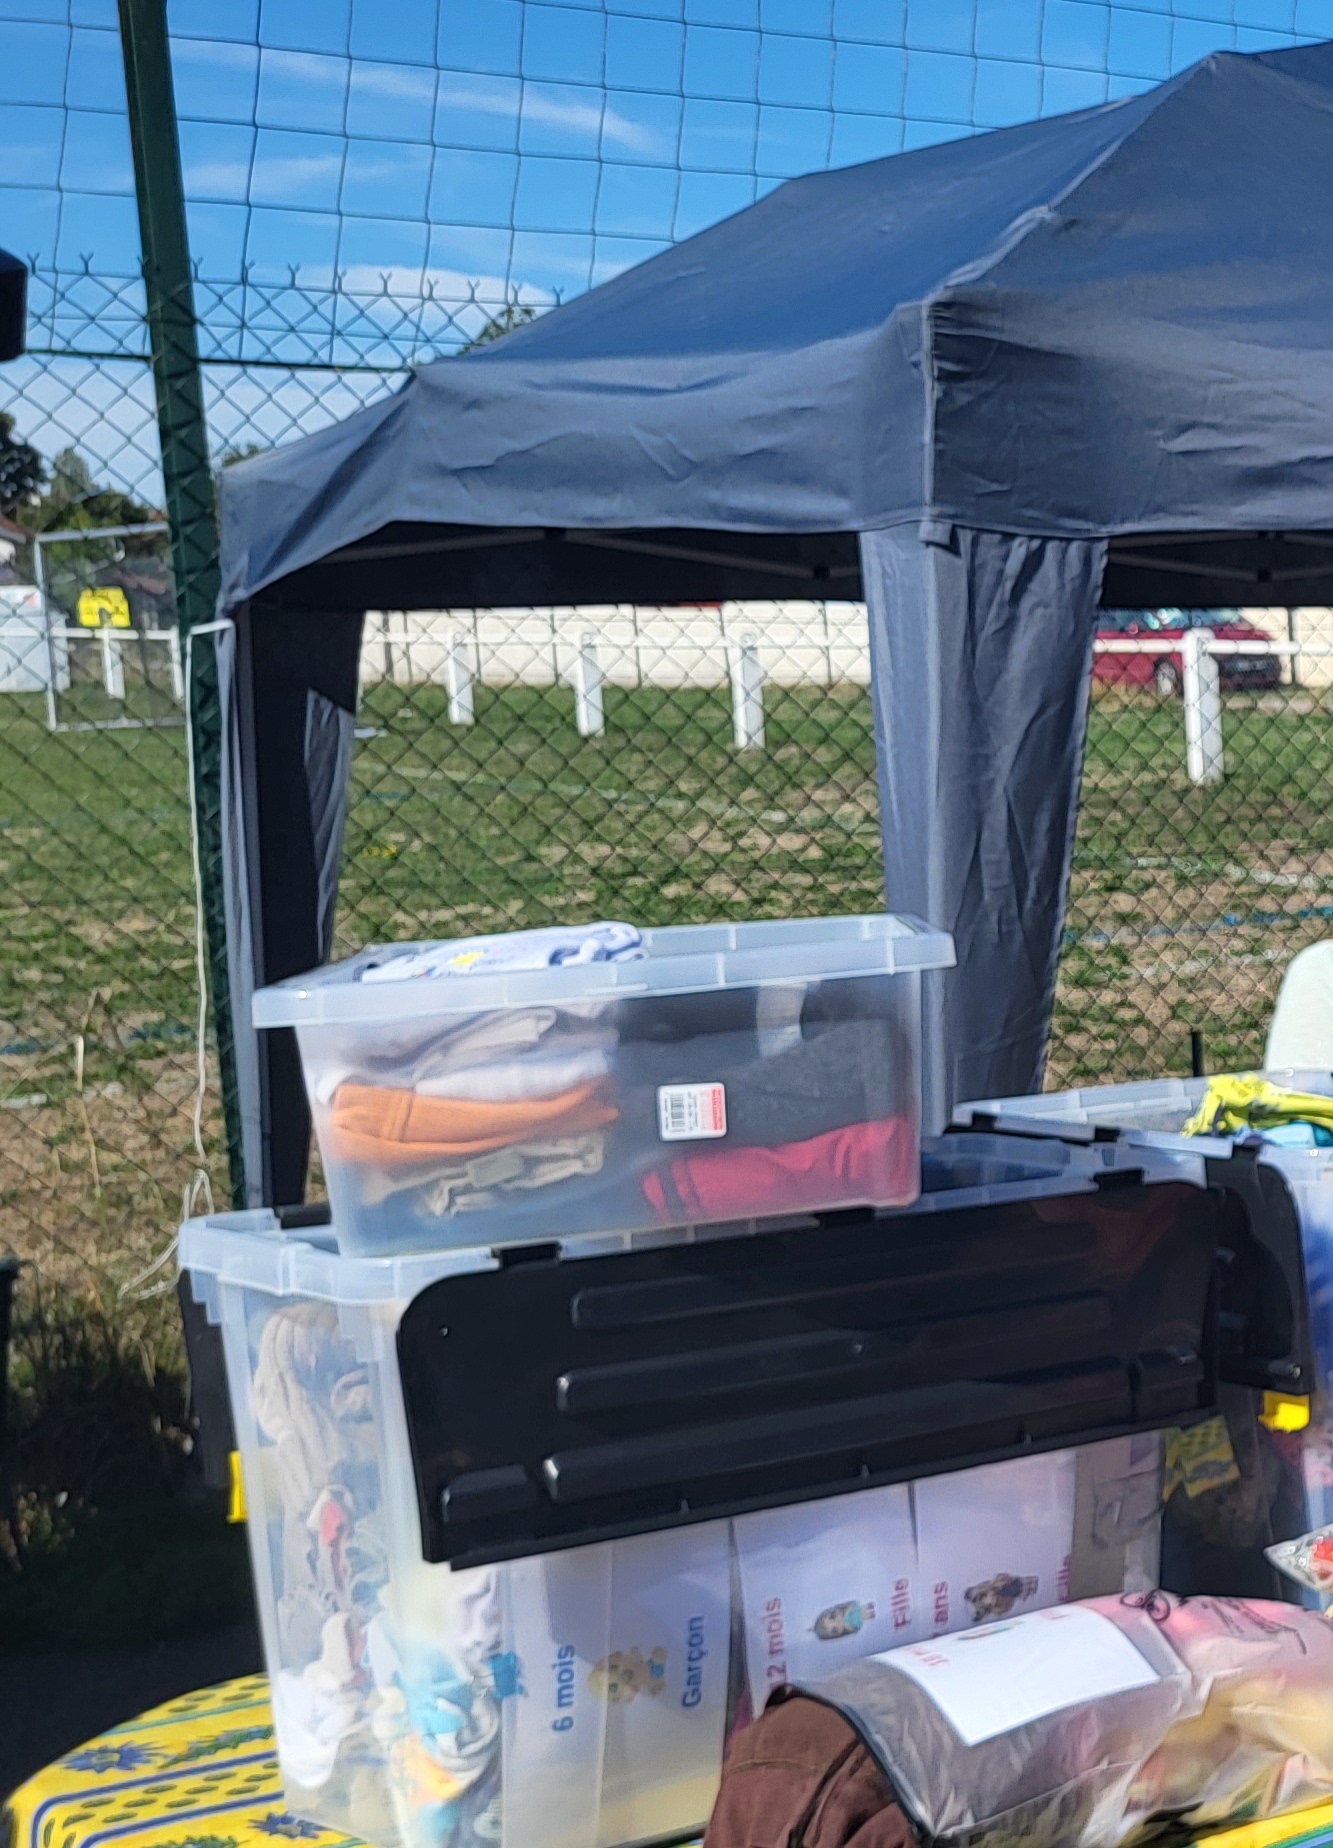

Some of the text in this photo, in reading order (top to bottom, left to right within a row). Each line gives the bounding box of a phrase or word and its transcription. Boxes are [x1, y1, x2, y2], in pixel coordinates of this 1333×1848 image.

[765, 1596, 786, 1657] mois
[889, 1576, 912, 1631] Fille
[932, 1580, 949, 1625] ans
[551, 1643, 576, 1732] 6 mois
[681, 1614, 709, 1708] Garçon
